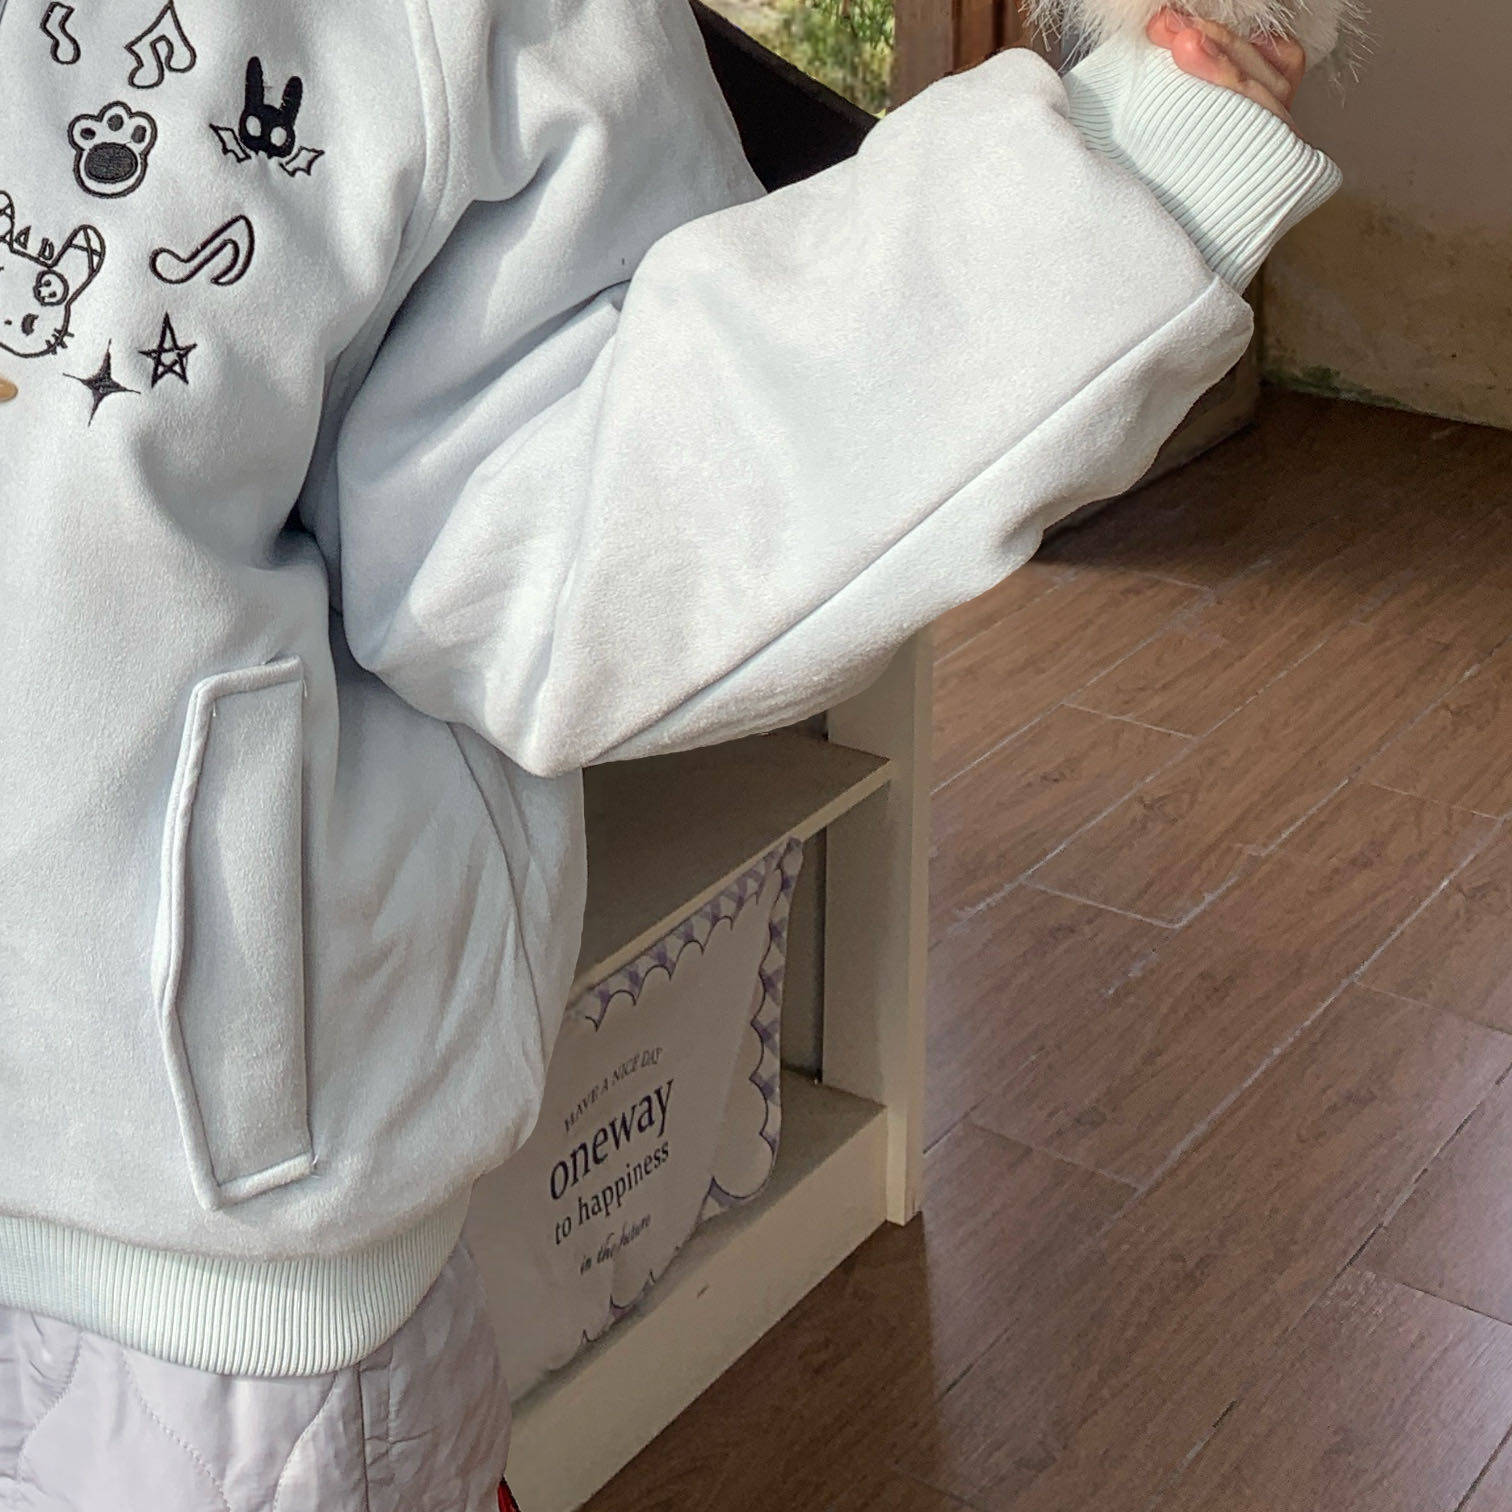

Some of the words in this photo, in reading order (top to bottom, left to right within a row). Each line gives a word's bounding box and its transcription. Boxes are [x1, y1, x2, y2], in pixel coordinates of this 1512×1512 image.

[549, 1078, 675, 1202] oneway
[555, 1216, 572, 1246] to
[577, 1141, 670, 1227] happiness
